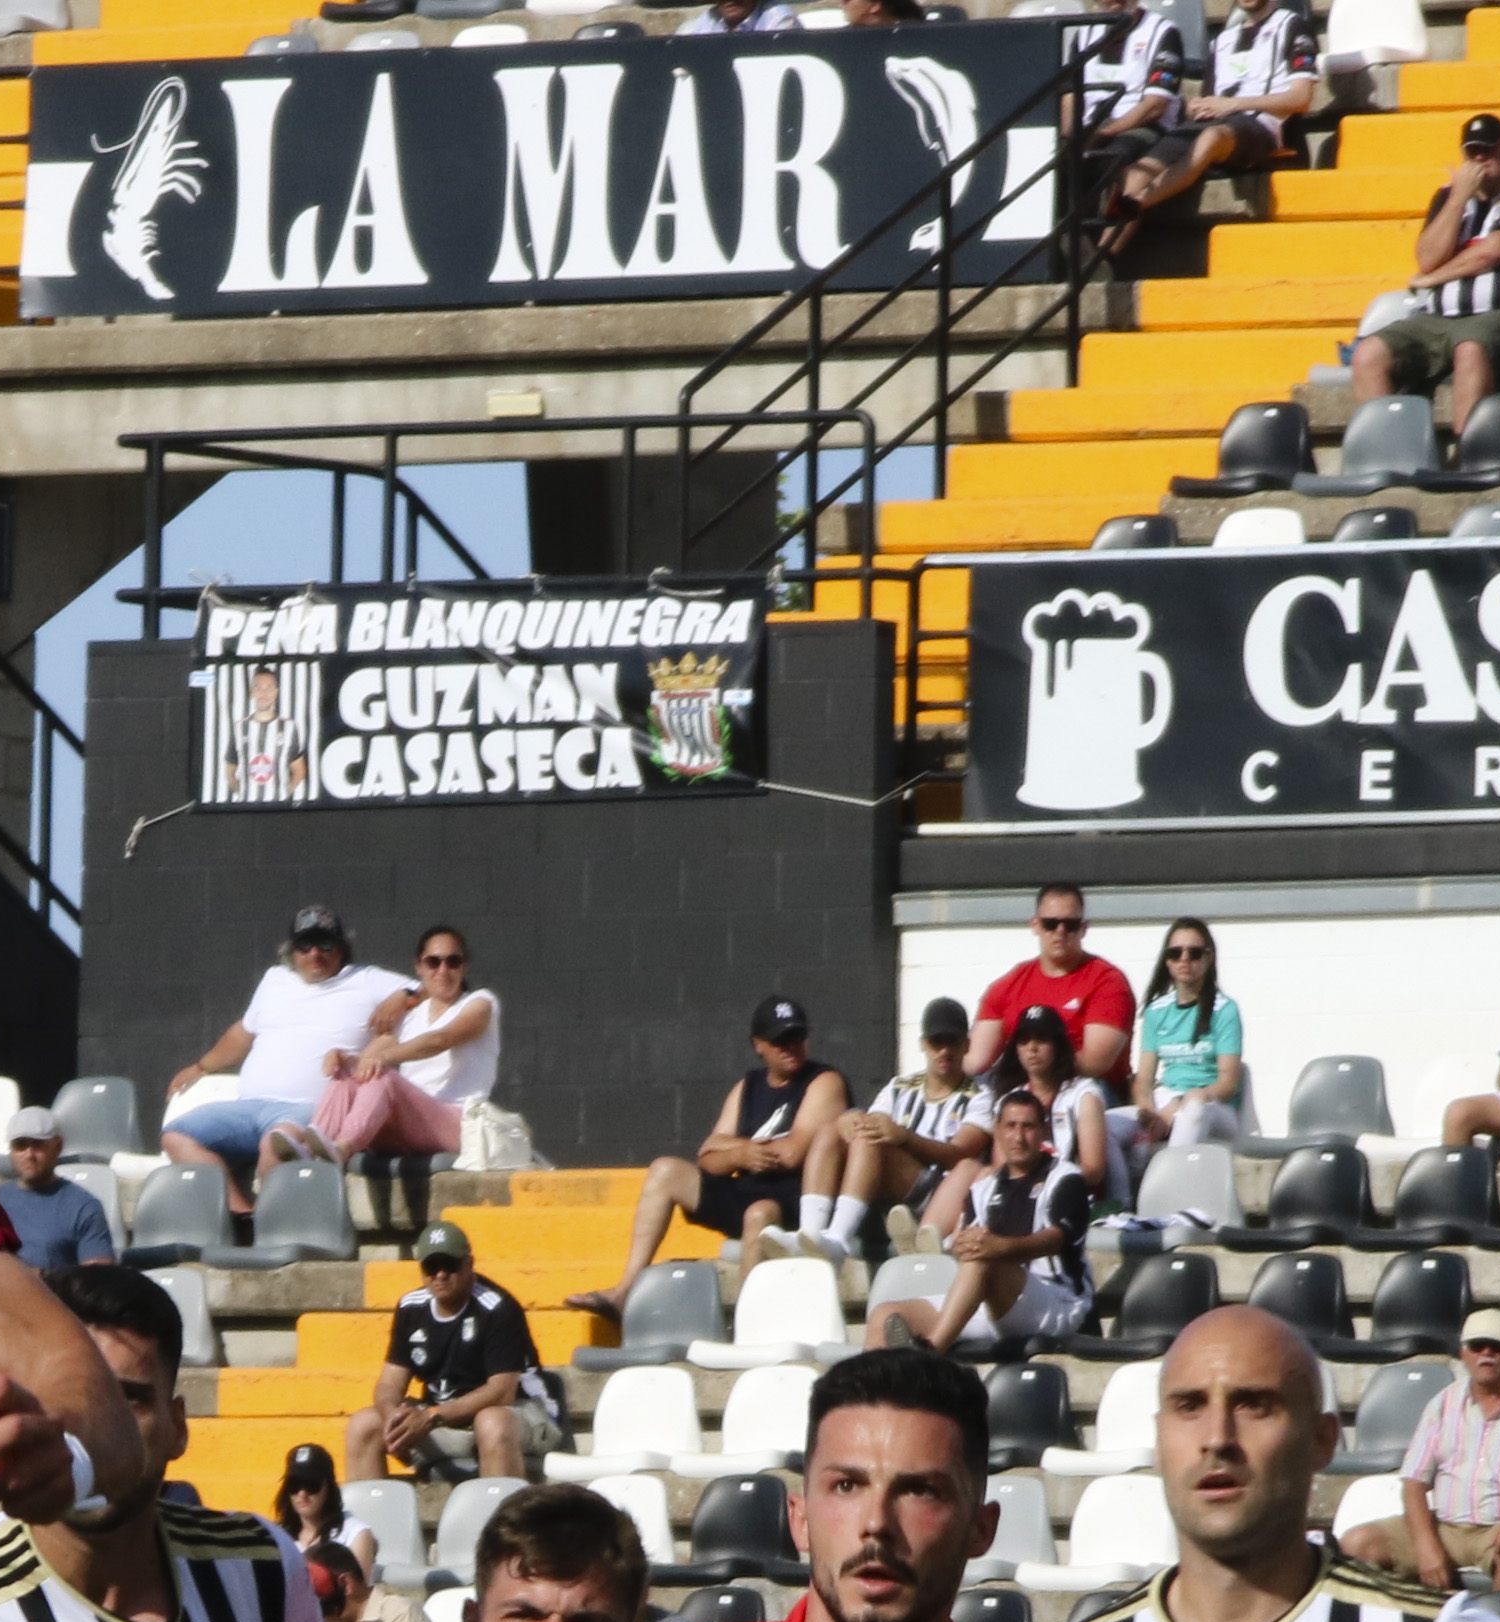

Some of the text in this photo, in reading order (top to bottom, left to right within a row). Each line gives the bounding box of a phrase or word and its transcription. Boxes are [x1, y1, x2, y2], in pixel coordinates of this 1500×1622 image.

[218, 53, 852, 294] LA MAR
[205, 597, 755, 657] PEÑA BLANQUINEGRA
[337, 663, 623, 732] GUZMAN
[319, 727, 643, 801] CASASECA
